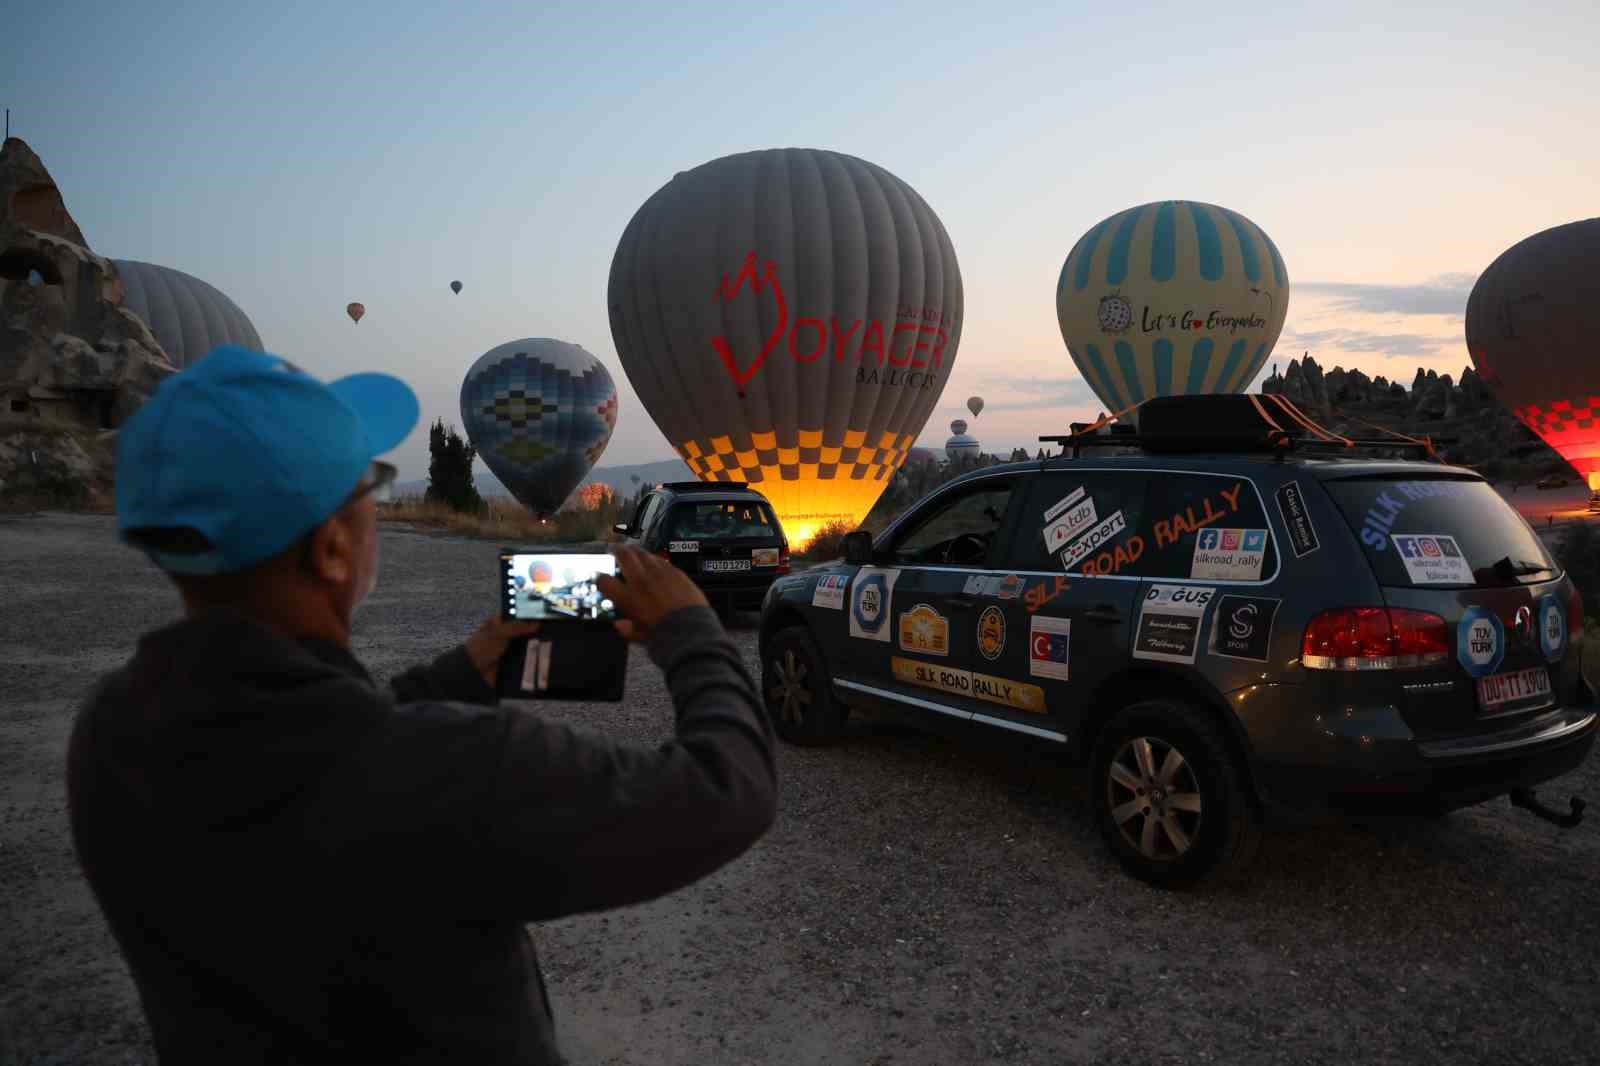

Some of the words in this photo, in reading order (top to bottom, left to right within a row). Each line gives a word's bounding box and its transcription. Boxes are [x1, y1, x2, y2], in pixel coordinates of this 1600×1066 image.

[1082, 534, 1148, 578] ROAD
[1153, 481, 1242, 550] RALLY
[1361, 489, 1406, 551] SILK
[1194, 552, 1262, 569] silkroad_rally
[915, 667, 937, 682] SILK
[940, 671, 969, 690] ROAD
[974, 679, 1011, 700] RALLY
